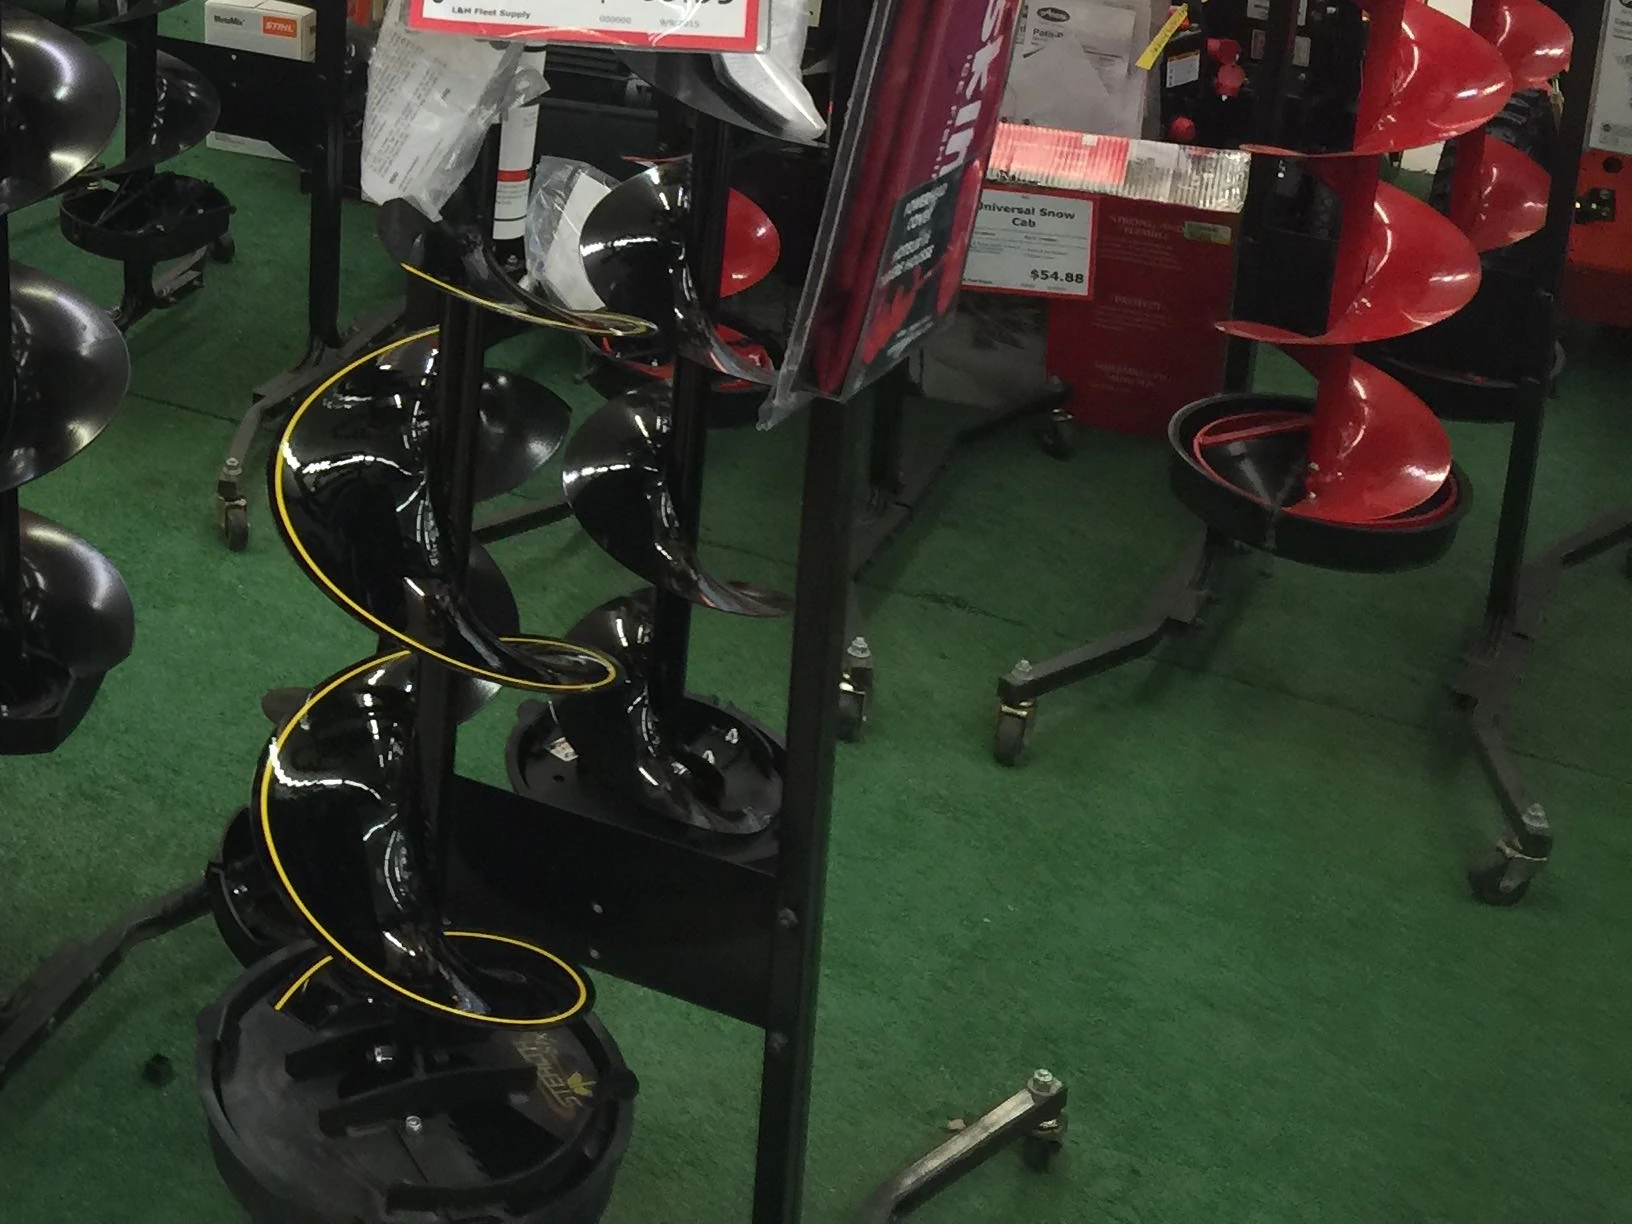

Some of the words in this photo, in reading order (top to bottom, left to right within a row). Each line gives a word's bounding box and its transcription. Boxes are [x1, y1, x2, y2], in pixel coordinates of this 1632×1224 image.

[452, 6, 471, 15] L&M
[474, 7, 496, 17] Fleet
[499, 8, 531, 19] Supply
[1040, 208, 1075, 220] Snow
[1012, 217, 1036, 228] Cab
[1031, 268, 1085, 284] $54.88
